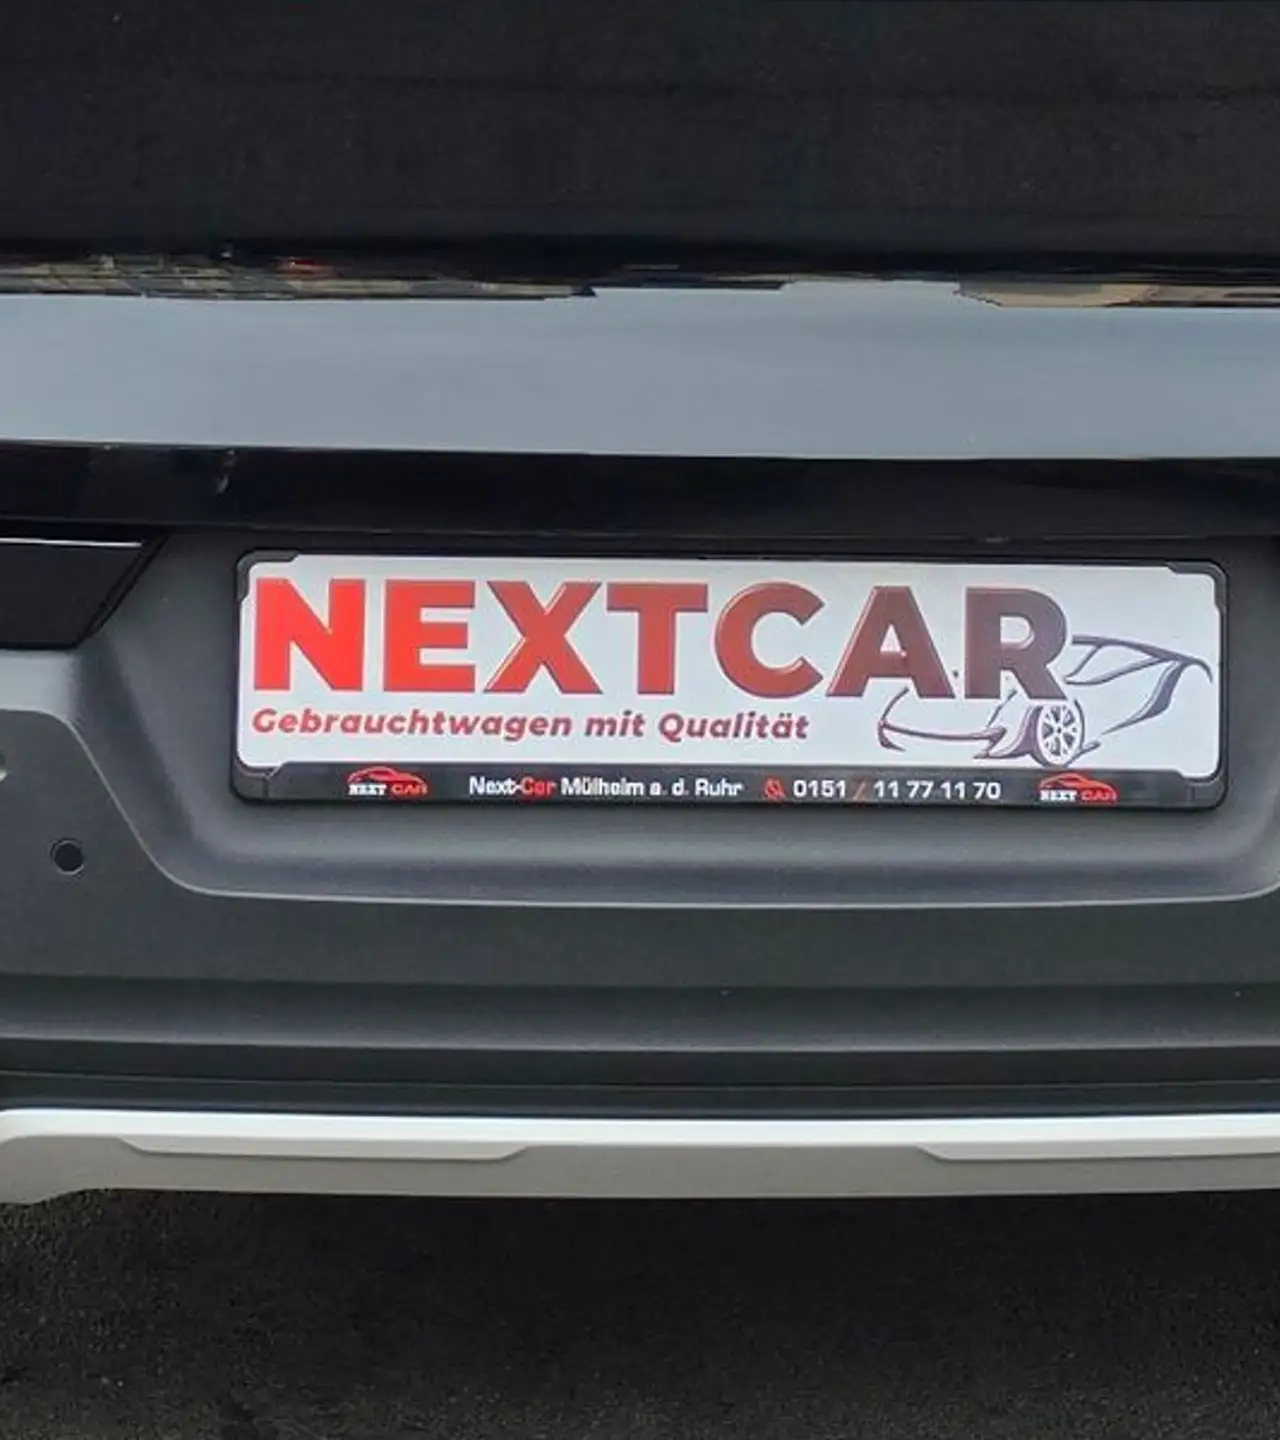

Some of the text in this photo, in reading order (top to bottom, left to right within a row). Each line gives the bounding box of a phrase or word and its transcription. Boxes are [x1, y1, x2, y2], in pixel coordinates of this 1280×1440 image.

[252, 578, 1070, 699] NEXTCAR
[252, 708, 809, 742] Gebrauchtwagen mit Qualität
[561, 775, 644, 796] Mülheim
[695, 778, 743, 797] Ruhr
[793, 780, 846, 798] 0151
[874, 780, 900, 798] 11
[907, 780, 933, 799] 77
[940, 781, 966, 799] 11
[974, 781, 1001, 799] 70
